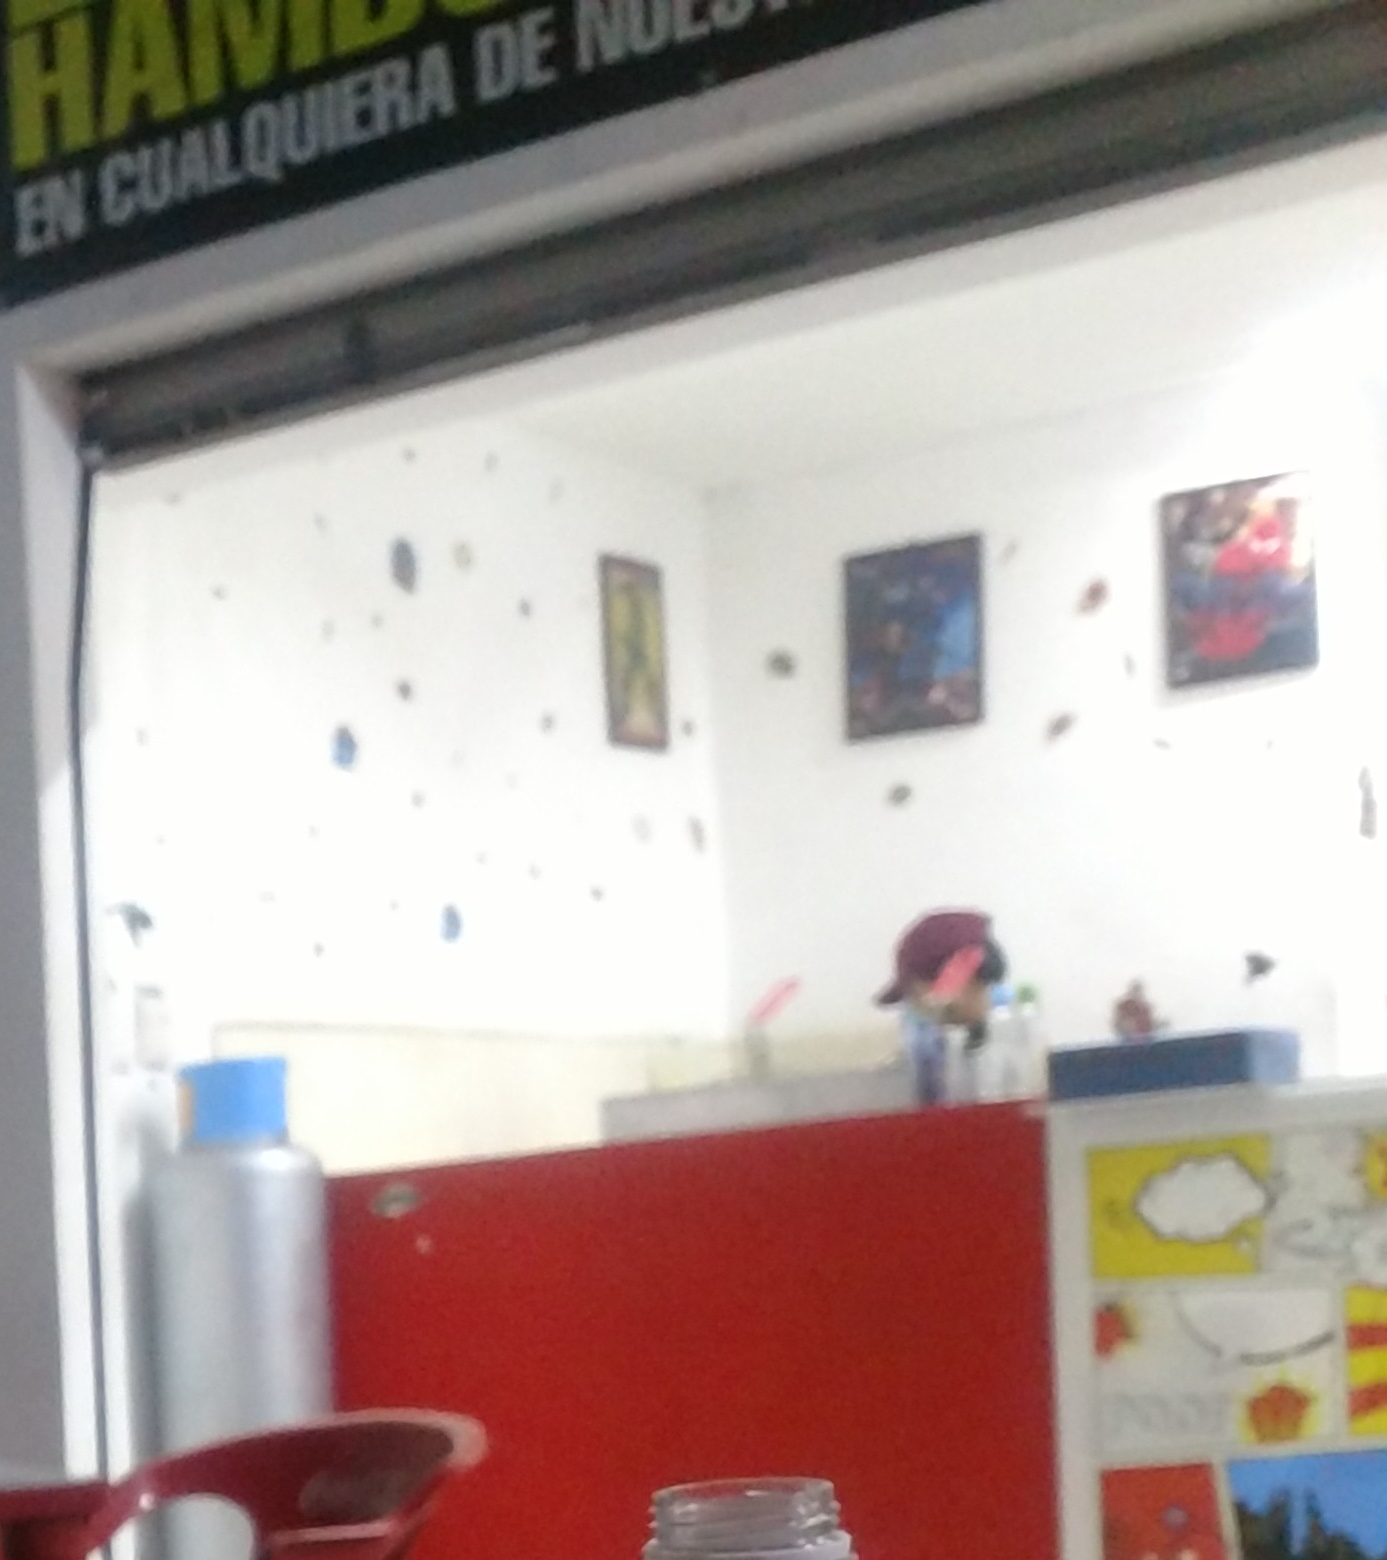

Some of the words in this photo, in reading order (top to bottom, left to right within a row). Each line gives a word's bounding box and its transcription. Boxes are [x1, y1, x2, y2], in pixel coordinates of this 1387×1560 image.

[7, 0, 505, 174] HAM
[13, 170, 87, 258] EN
[97, 41, 457, 228] CUALQUIERA
[473, 9, 559, 101] DE
